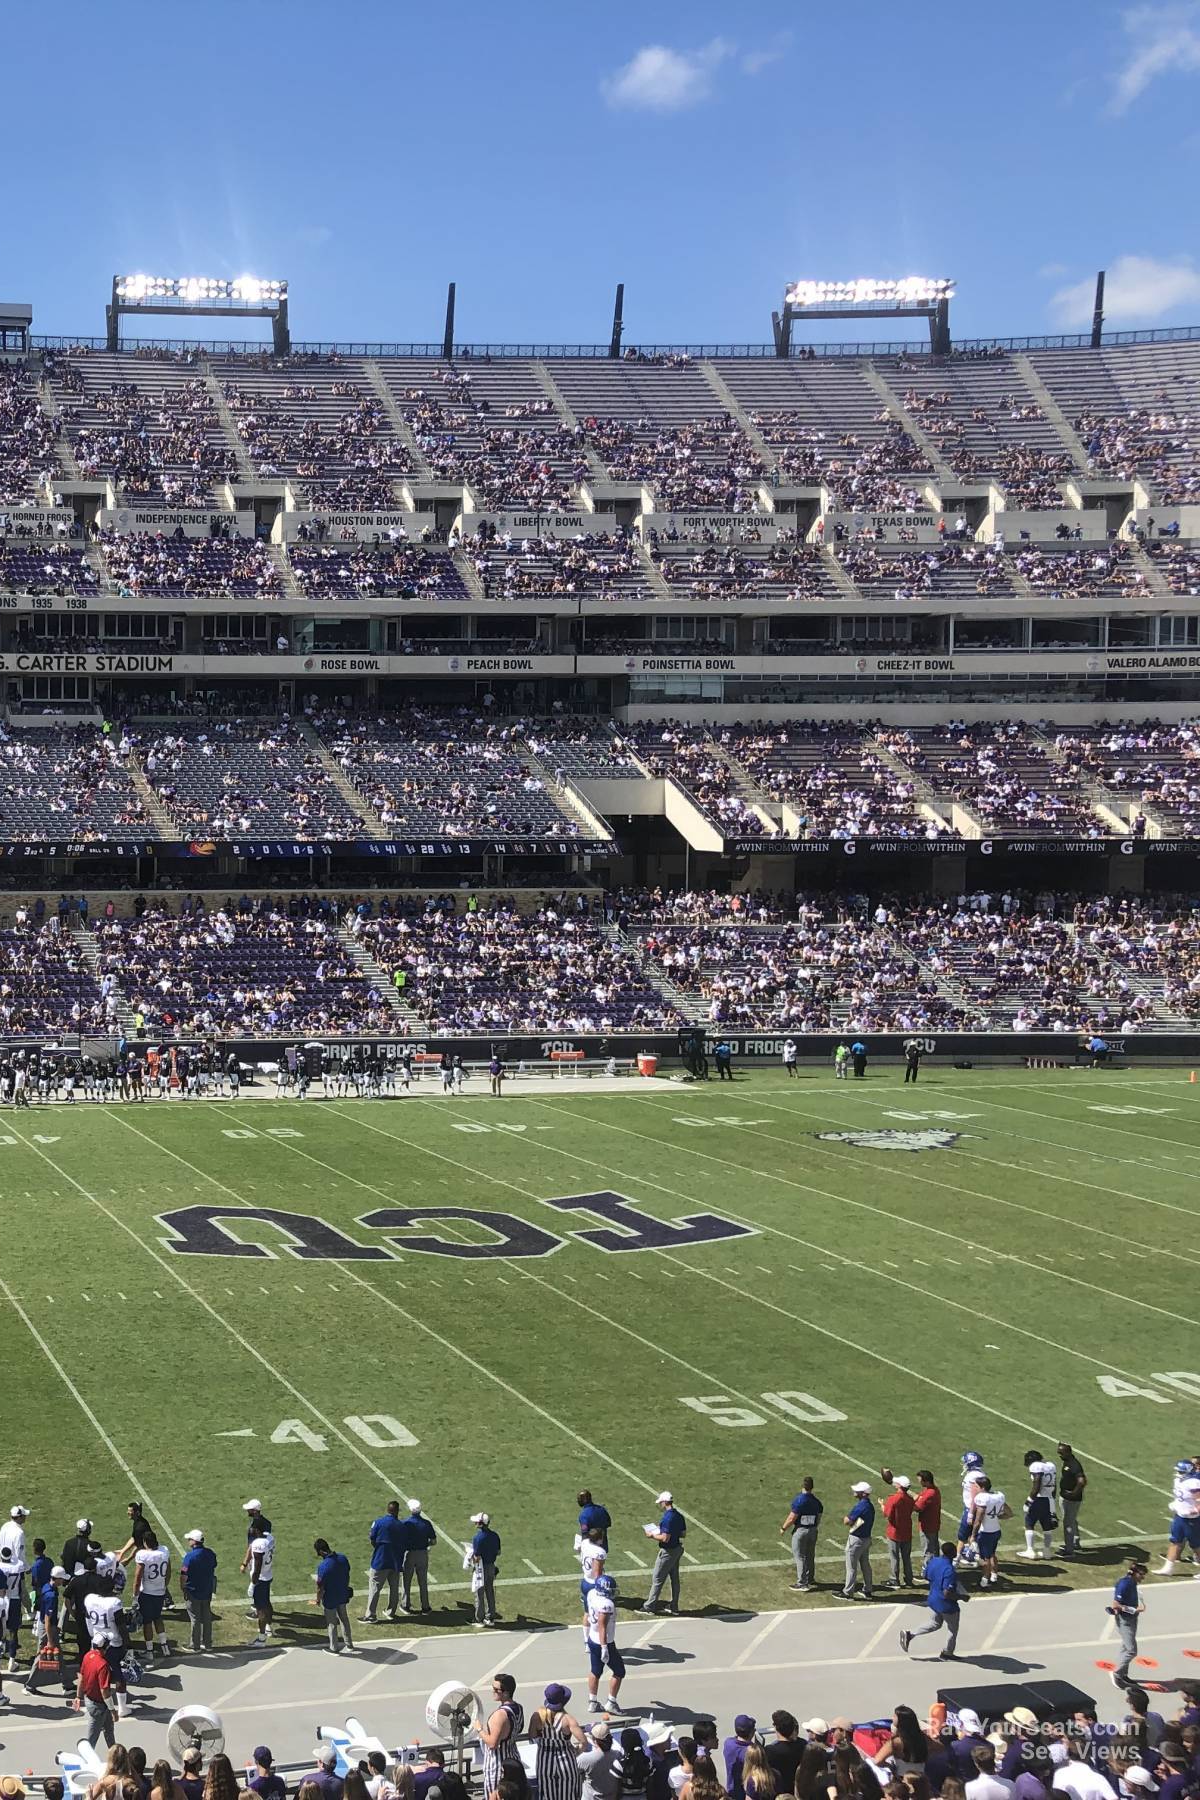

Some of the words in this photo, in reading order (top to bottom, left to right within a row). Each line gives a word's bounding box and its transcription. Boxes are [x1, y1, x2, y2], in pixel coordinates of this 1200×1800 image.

[12, 512, 44, 521] HORNED
[136, 514, 208, 524] INDEPENDENCE
[211, 514, 238, 525] BOWL
[328, 516, 374, 526] HOUSTON
[376, 516, 405, 526] BOWL
[514, 517, 552, 526] LIBERTY
[556, 518, 584, 526] BOWL
[871, 517, 902, 526] TEXAS
[906, 518, 936, 526] BOWL
[684, 518, 706, 526] FORT
[709, 518, 744, 526] WORTH
[746, 518, 776, 526] BOWL
[31, 598, 52, 608] 1935
[65, 599, 87, 609] 1938
[16, 655, 87, 671] CARTER
[96, 656, 173, 672] STADIUM
[320, 660, 347, 670] ROSE
[350, 660, 380, 670] BOWL
[467, 660, 500, 670] PEACH
[503, 660, 534, 670] BOWL
[642, 660, 702, 670] POINSETTIA
[705, 660, 736, 670] BOWL
[877, 660, 922, 670] CHEEZ-IT
[924, 660, 955, 670] BOWL
[1107, 658, 1146, 668] VALERO
[1148, 656, 1188, 668] ALAMO
[50, 846, 56, 855] 5
[233, 846, 240, 854] 2
[262, 846, 270, 854] 0
[385, 845, 396, 854] 41
[421, 845, 434, 854] 28
[459, 845, 470, 854] 13
[494, 844, 506, 853] 14
[530, 844, 536, 852] 7
[560, 844, 566, 852] 0
[377, 1044, 426, 1058] FROGS
[541, 1040, 574, 1056] TCU
[745, 1040, 785, 1054] FROG
[152, 1189, 763, 1262] TCU
[678, 1390, 848, 1427] 50
[270, 1414, 422, 1452] 40
[148, 1560, 168, 1580] 30
[88, 1610, 110, 1629] 91
